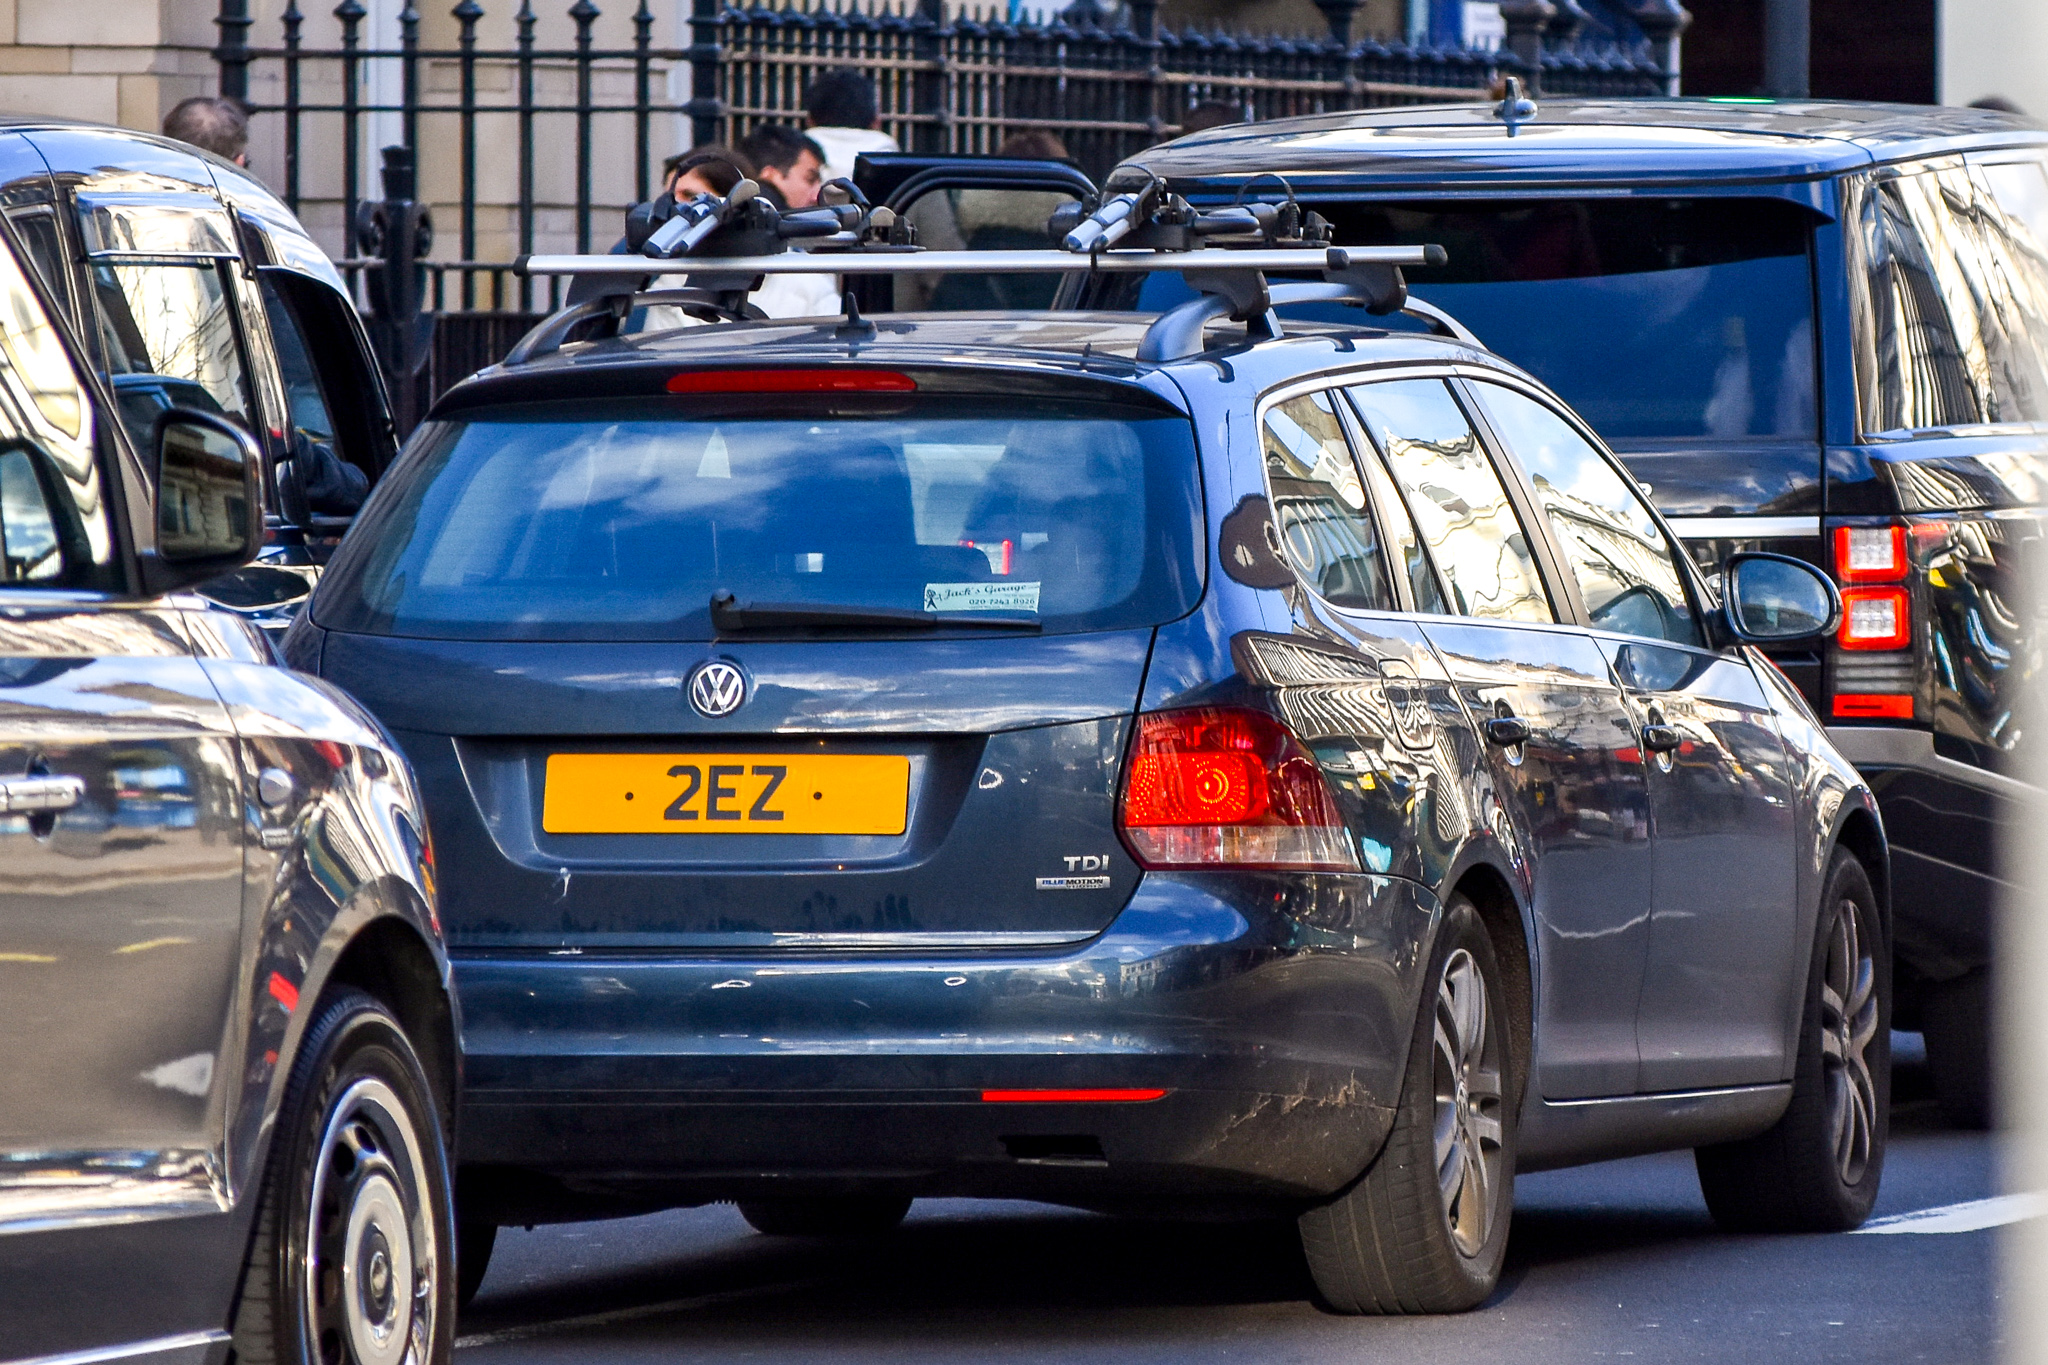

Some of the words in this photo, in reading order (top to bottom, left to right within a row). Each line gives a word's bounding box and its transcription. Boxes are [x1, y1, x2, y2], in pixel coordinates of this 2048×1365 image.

[984, 584, 1026, 594] Garage
[693, 663, 743, 715] VW
[663, 764, 788, 821] 2EZ
[1063, 854, 1110, 872] TDI
